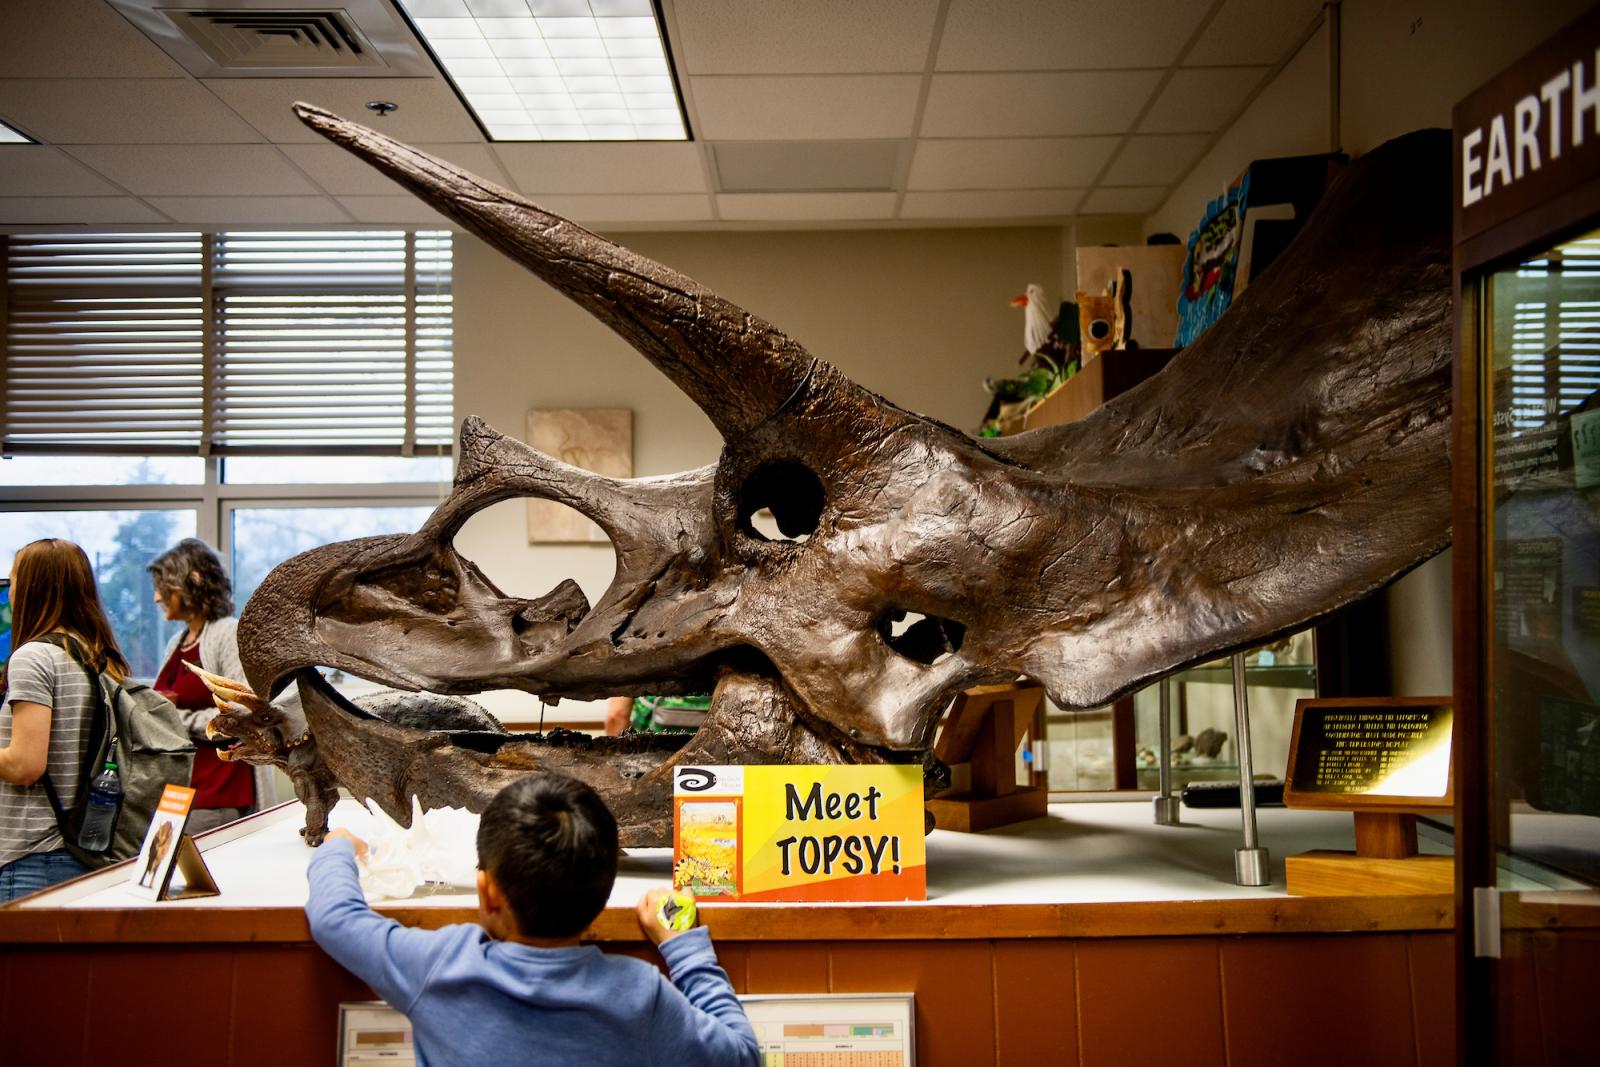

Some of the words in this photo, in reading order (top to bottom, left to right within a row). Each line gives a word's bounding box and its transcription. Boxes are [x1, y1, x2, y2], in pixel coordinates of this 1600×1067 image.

[1462, 48, 1600, 208] EARTH
[785, 782, 881, 821] Meet
[776, 835, 902, 875] TOPSY!
